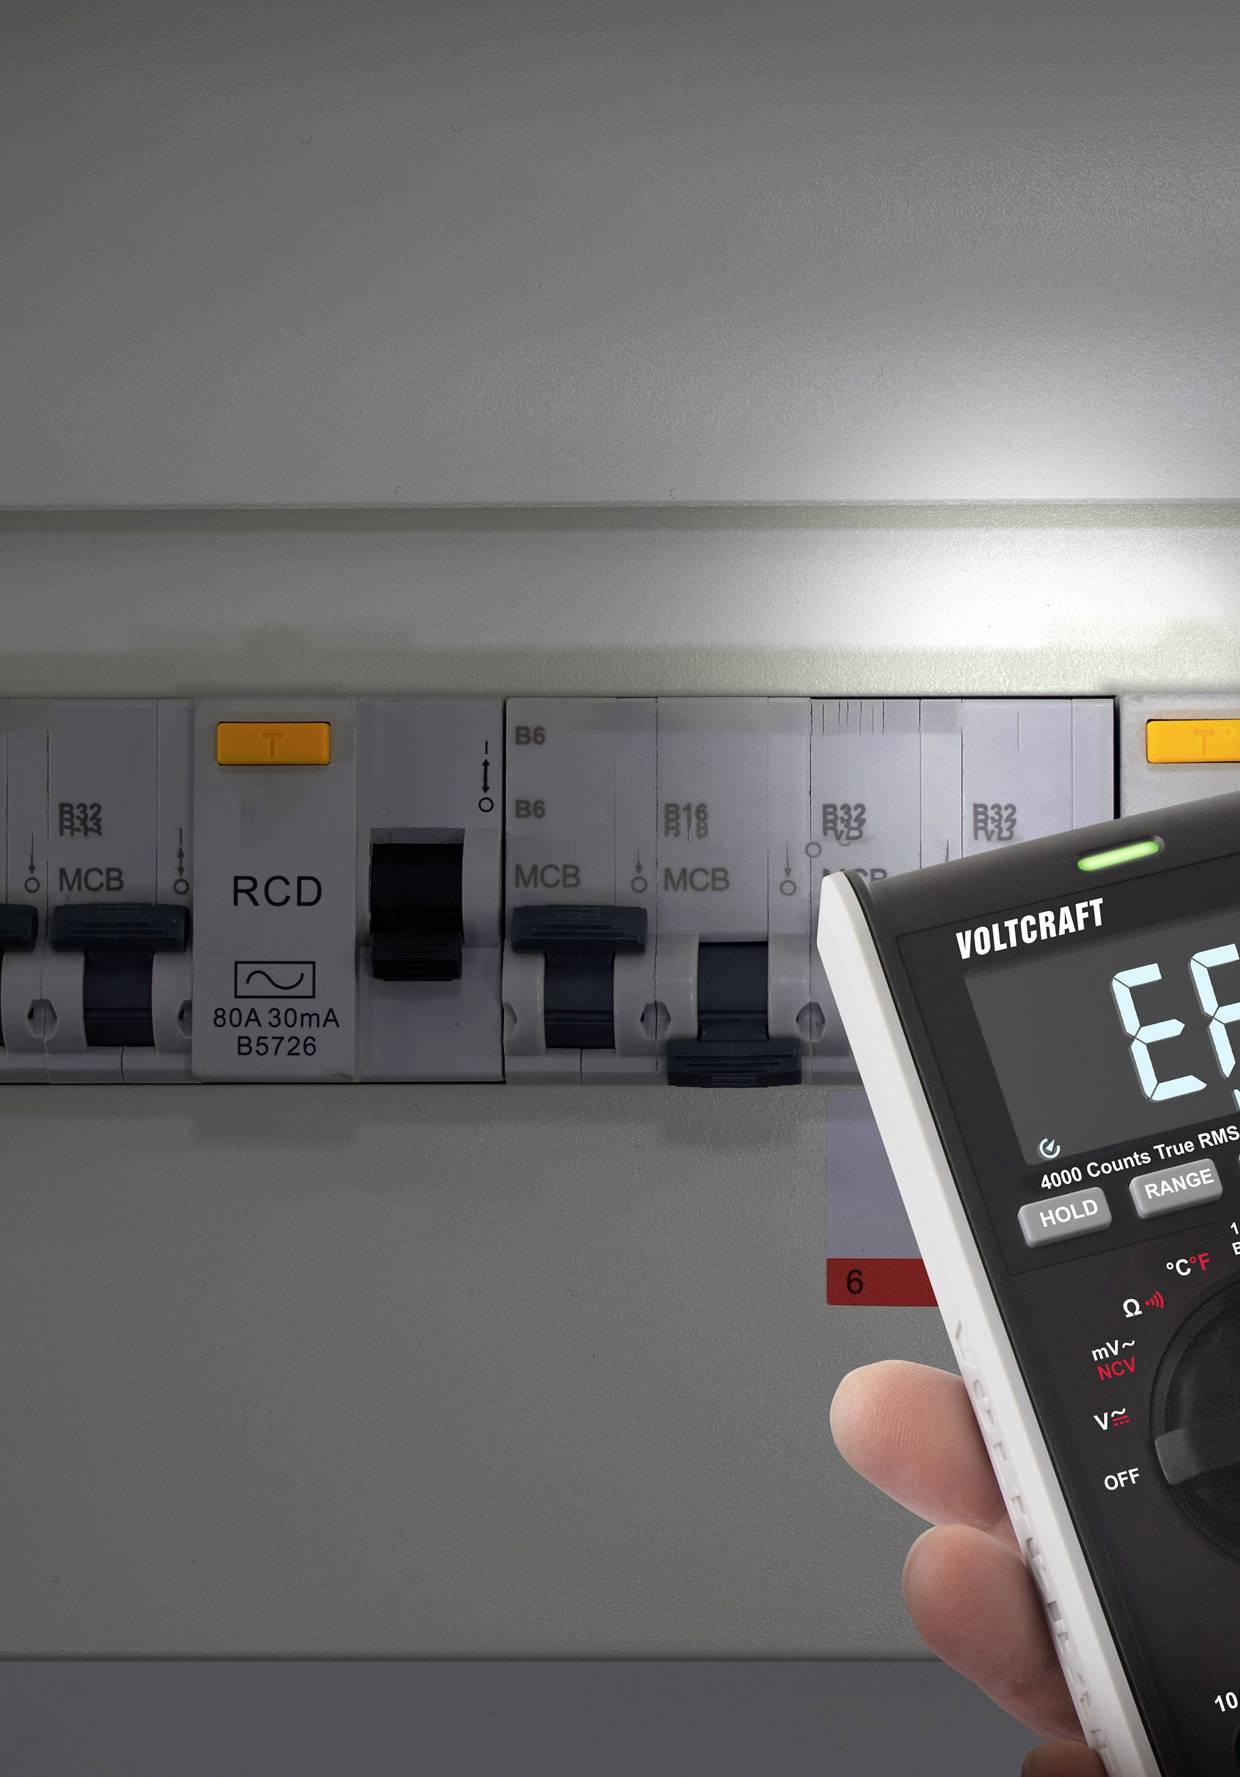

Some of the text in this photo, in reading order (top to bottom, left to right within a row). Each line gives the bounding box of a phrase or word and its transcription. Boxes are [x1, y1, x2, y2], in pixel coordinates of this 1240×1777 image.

[515, 725, 546, 746] B6
[514, 799, 546, 819] B6
[58, 867, 125, 893] MCB
[514, 863, 581, 889] MCB
[663, 867, 730, 893] MCB
[233, 875, 322, 907] RCD
[955, 897, 1104, 960] VOLTCRAFT
[213, 1007, 340, 1028] 80A 30mA
[237, 1035, 317, 1057] B5726
[1040, 1166, 1083, 1190] 4000
[1086, 1151, 1152, 1178] Counts
[1153, 1140, 1195, 1160] True
[1197, 1125, 1240, 1149] RMS
[1143, 1167, 1215, 1200] RANGE
[1039, 1199, 1098, 1228] HOLD
[846, 1269, 864, 1294] 6
[1122, 1297, 1143, 1319] Ω
[1097, 1359, 1135, 1380] NCV
[1104, 1467, 1140, 1491] OFF
